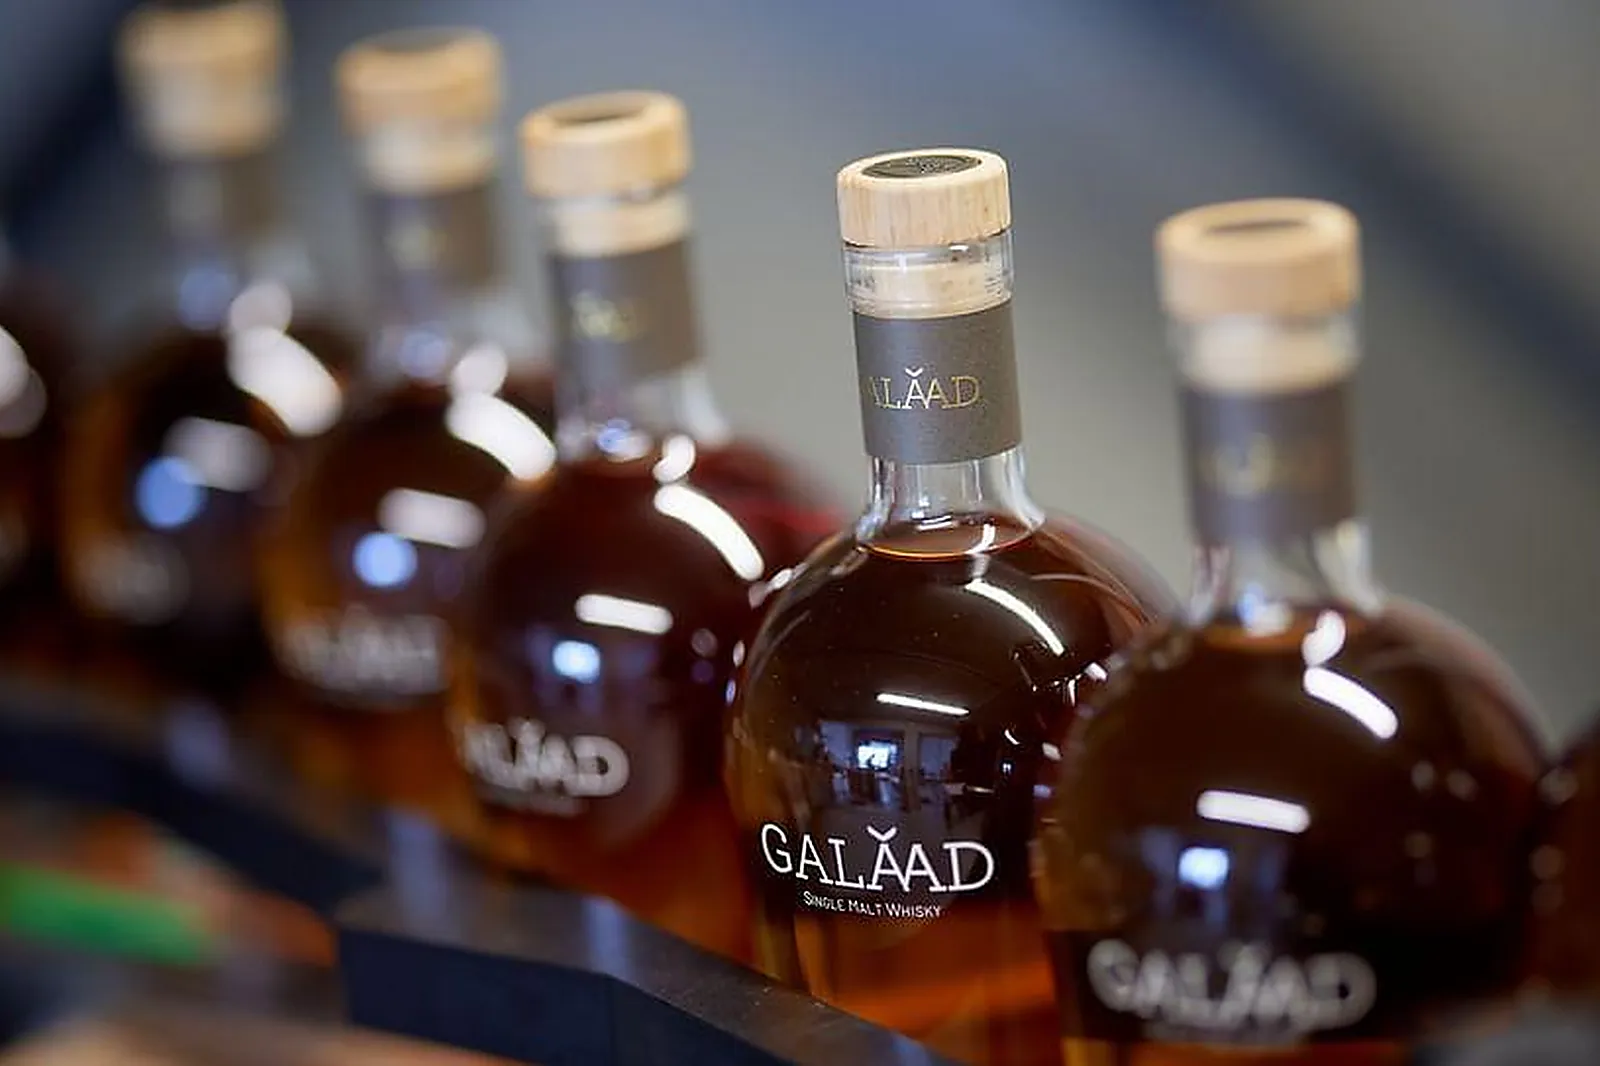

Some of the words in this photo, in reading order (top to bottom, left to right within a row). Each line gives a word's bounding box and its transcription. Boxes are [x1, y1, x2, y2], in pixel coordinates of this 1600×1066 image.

[802, 890, 846, 912] SINGLE
[848, 899, 882, 916] MALT
[885, 903, 942, 918] WHISKY
